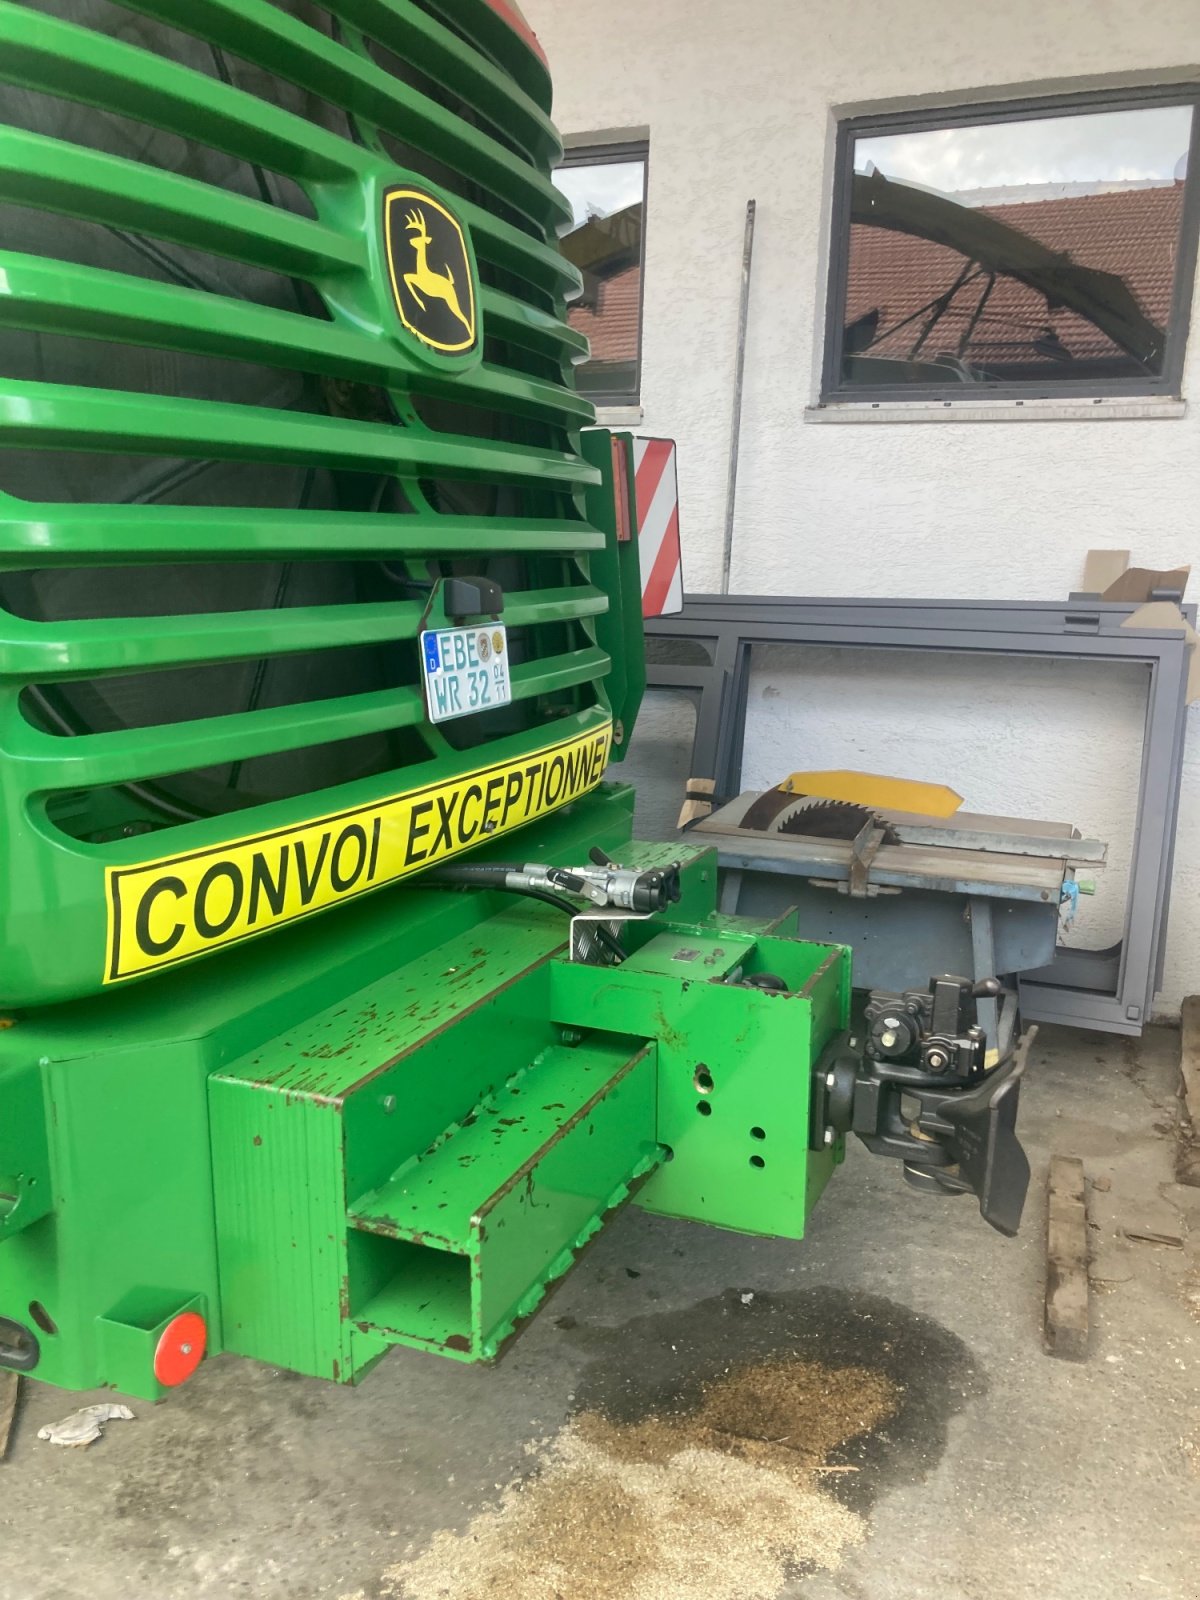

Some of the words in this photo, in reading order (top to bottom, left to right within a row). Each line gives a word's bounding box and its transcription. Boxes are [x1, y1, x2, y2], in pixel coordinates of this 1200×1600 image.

[430, 658, 436, 670] D
[440, 632, 479, 672] EBE
[434, 675, 462, 714] WR
[468, 669, 491, 706] 32
[135, 817, 382, 956] CONVOI
[404, 734, 608, 868] EXCEPTIONNEL
